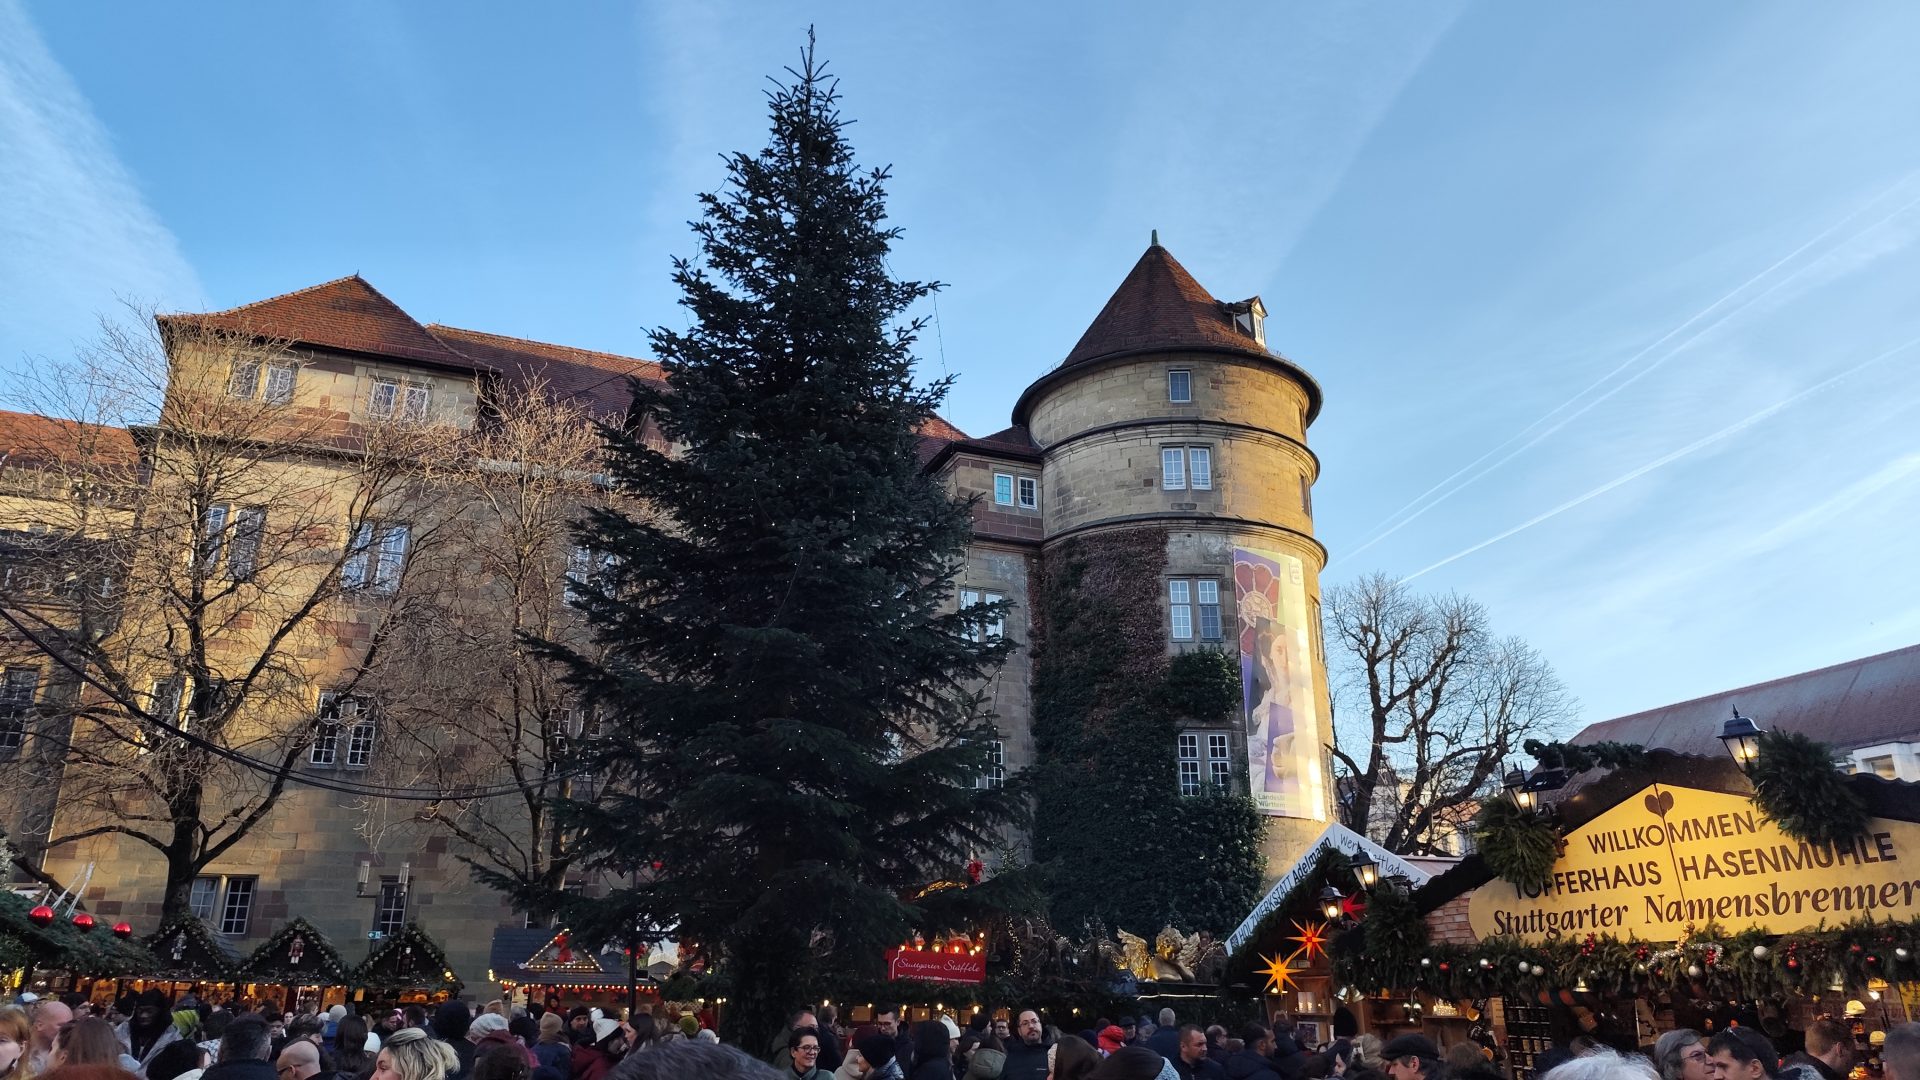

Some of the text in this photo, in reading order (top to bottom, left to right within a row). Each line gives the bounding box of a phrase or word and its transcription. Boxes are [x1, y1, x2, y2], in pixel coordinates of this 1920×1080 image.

[1340, 833, 1411, 877] Werkattlade
[1587, 810, 1756, 855] WILLKOMMEN
[1292, 836, 1332, 886] Adelmann
[1494, 878, 1920, 941] Stuttgarter Namensbrenner
[897, 958, 940, 972] Stuttgarter
